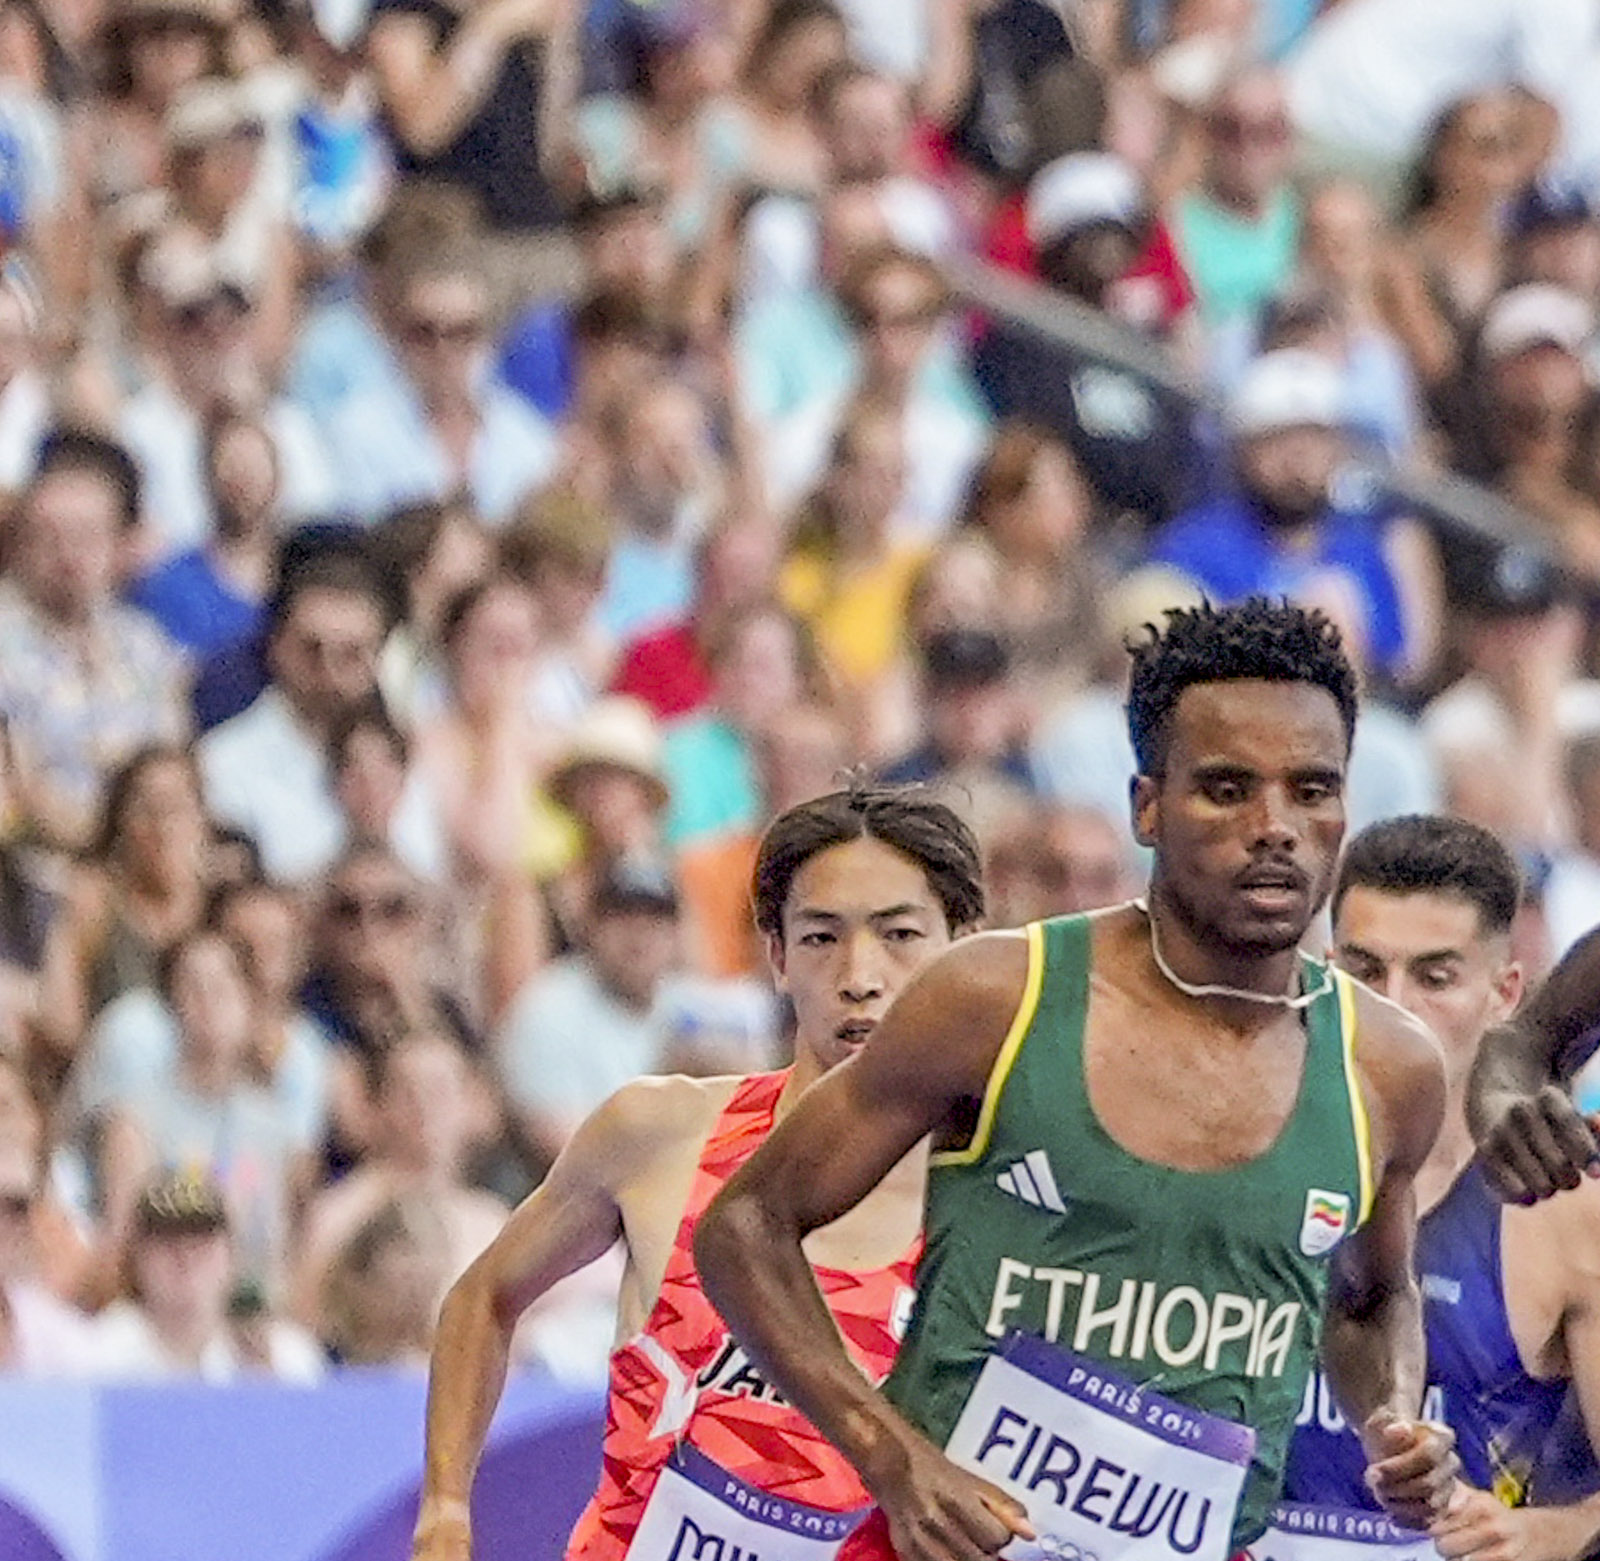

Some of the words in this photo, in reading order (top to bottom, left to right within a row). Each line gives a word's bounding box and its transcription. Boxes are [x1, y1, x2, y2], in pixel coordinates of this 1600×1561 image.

[985, 1256, 1300, 1378] ETHIOPIA
[696, 1336, 792, 1408] JA
[1067, 1367, 1142, 1415] PARIS
[725, 1480, 784, 1521] PARIS
[975, 1405, 1213, 1555] FIREWU
